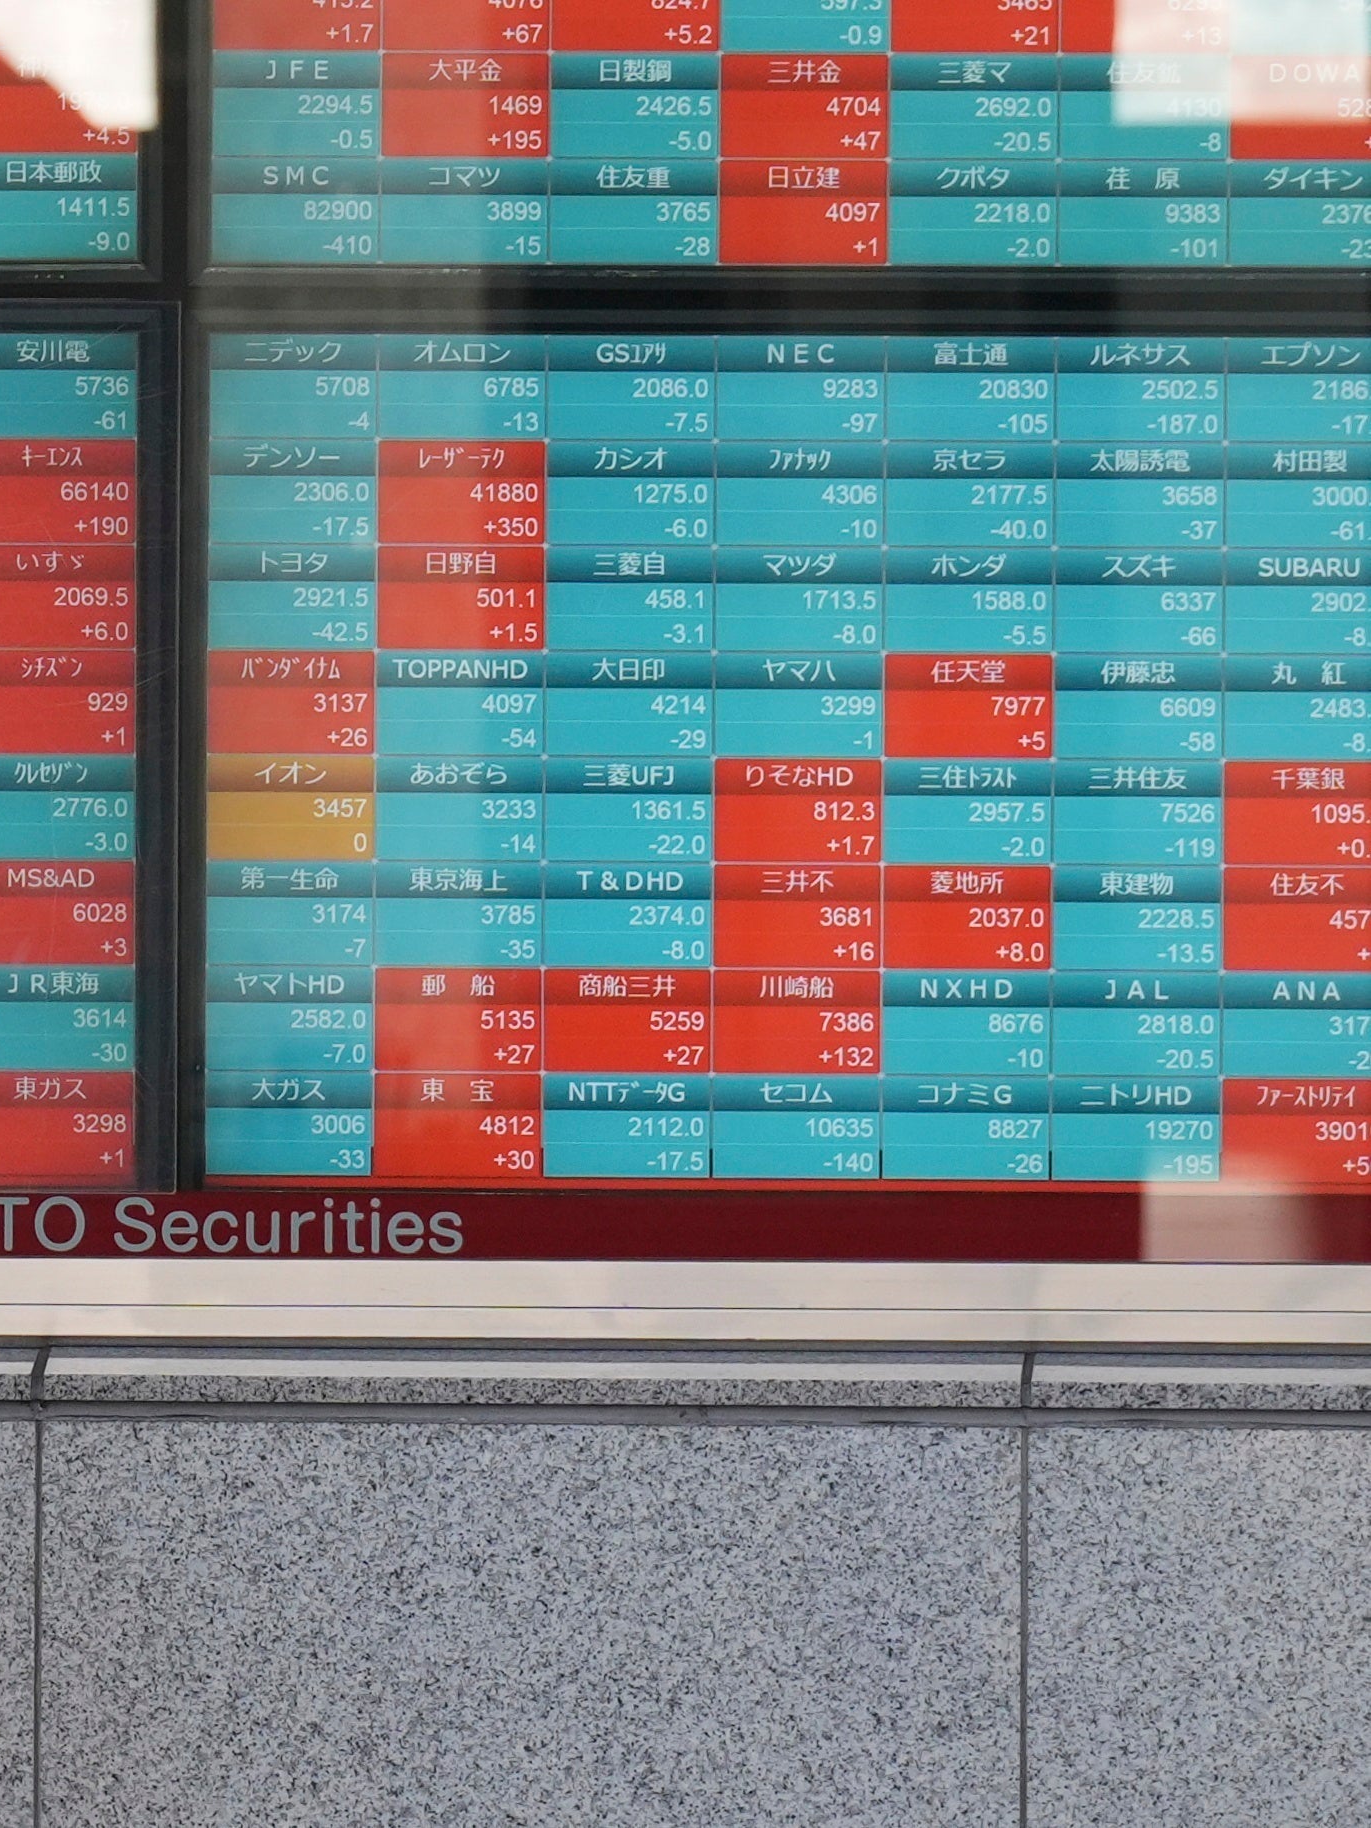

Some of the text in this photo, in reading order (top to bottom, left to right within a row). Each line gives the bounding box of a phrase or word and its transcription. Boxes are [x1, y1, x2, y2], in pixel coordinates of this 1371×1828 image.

[664, 24, 713, 45] +5.2
[428, 57, 503, 82] 大平金
[599, 58, 672, 83] 日製鋼
[767, 59, 842, 84] 三井金
[937, 58, 1011, 84] 三菱マ
[297, 94, 373, 115] 2294.5
[489, 94, 543, 116] 1469
[635, 95, 713, 117] 2426.5
[825, 96, 882, 117] 4704
[974, 96, 1052, 118] 2692.0
[6, 159, 102, 184] 日本郵政
[428, 165, 501, 188] コマツ
[595, 164, 671, 189] 住友重
[768, 165, 841, 189] 日立建
[936, 164, 1011, 190] クボタ
[1263, 166, 1364, 192] ダイキン
[56, 196, 130, 217] 1411.5
[303, 199, 374, 221] 82900
[486, 200, 542, 222] 3899
[655, 201, 711, 223] 3765
[824, 201, 881, 223] 4097
[973, 197, 1051, 224] 2218.0
[1164, 202, 1222, 224] 9383
[16, 338, 91, 363] 安川電
[244, 336, 342, 364] ニデック
[413, 339, 511, 364] オムロン
[933, 340, 1009, 366] 富士通
[1089, 342, 1191, 367] ルネサス
[1260, 340, 1361, 368] エプソン
[75, 374, 130, 397] 5736
[315, 375, 371, 397] 5708
[632, 377, 709, 399] 2086.0
[978, 378, 1049, 400] 20830
[1146, 413, 1219, 435] -187.0
[243, 442, 341, 469] デンソー
[593, 446, 668, 471] カシオ
[932, 447, 1006, 472] 京セラ
[1089, 448, 1191, 473] 太陽誘電
[1271, 448, 1348, 474] 村田製
[469, 482, 539, 503] 41880
[820, 483, 878, 505] 4306
[1161, 484, 1218, 506] 3658
[312, 515, 369, 537] -17.5
[989, 519, 1048, 540] -40.0
[261, 550, 329, 575] トヨタ
[426, 549, 496, 575] 日野自
[592, 549, 666, 576] 三菱自
[762, 551, 838, 577] マツダ
[930, 552, 1007, 578] ホンダ
[1101, 553, 1177, 578] スズキ
[1257, 557, 1361, 578] SUBARU
[53, 586, 129, 607] 2069.5
[292, 586, 369, 608] 2921.5
[644, 588, 704, 610] 458.1
[971, 590, 1047, 612] 1588.0
[391, 658, 529, 680] TOPPANHD
[591, 657, 665, 682] 大日印
[762, 658, 837, 682] ヤマハ
[930, 659, 1006, 684] 任天堂
[1100, 659, 1176, 685] 伊藤忠
[481, 693, 538, 714] 4097
[820, 695, 877, 716] 3299
[1159, 696, 1217, 718] 6609
[254, 760, 327, 785] イオン
[409, 761, 508, 786] あおぞら
[582, 763, 675, 787] 三菱UFJ
[745, 764, 854, 788] りそなHD
[1088, 765, 1188, 790] 三井住友
[1270, 766, 1346, 791] 千葉銀
[52, 795, 129, 818] 2776.0
[312, 797, 368, 819] 3457
[631, 799, 706, 821] 1361.5
[968, 800, 1046, 823] 2957.5
[7, 867, 95, 888] MS&AD
[240, 865, 340, 891] 第一生命
[408, 866, 508, 892] 東京海上
[760, 869, 834, 894] 三井不
[930, 870, 1005, 895] 菱地所
[1098, 870, 1174, 897] 東建物
[1269, 872, 1345, 897] 住友不
[481, 903, 536, 925] 3785
[819, 906, 872, 927] 3681
[1137, 908, 1215, 929] 2228.5
[233, 972, 345, 996] ヤマトHD
[578, 972, 677, 998] 商船三井
[759, 974, 835, 999] 川崎船
[72, 1007, 128, 1029] 3614
[290, 1003, 367, 1030] 2582.0
[649, 1010, 705, 1032] 5259
[988, 1012, 1044, 1035] 8676
[818, 1046, 874, 1067] +132
[13, 1075, 87, 1101] 東ガス
[251, 1077, 326, 1102] 大ガス
[759, 1081, 833, 1104] セコム
[917, 1081, 1013, 1106] コナミG
[1079, 1082, 1192, 1107] ニトリHD
[478, 1115, 535, 1136] 4812
[805, 1112, 874, 1138] 10635
[1145, 1119, 1214, 1141] 19270
[646, 1149, 710, 1172] -17.5
[114, 1196, 464, 1255] Securities
